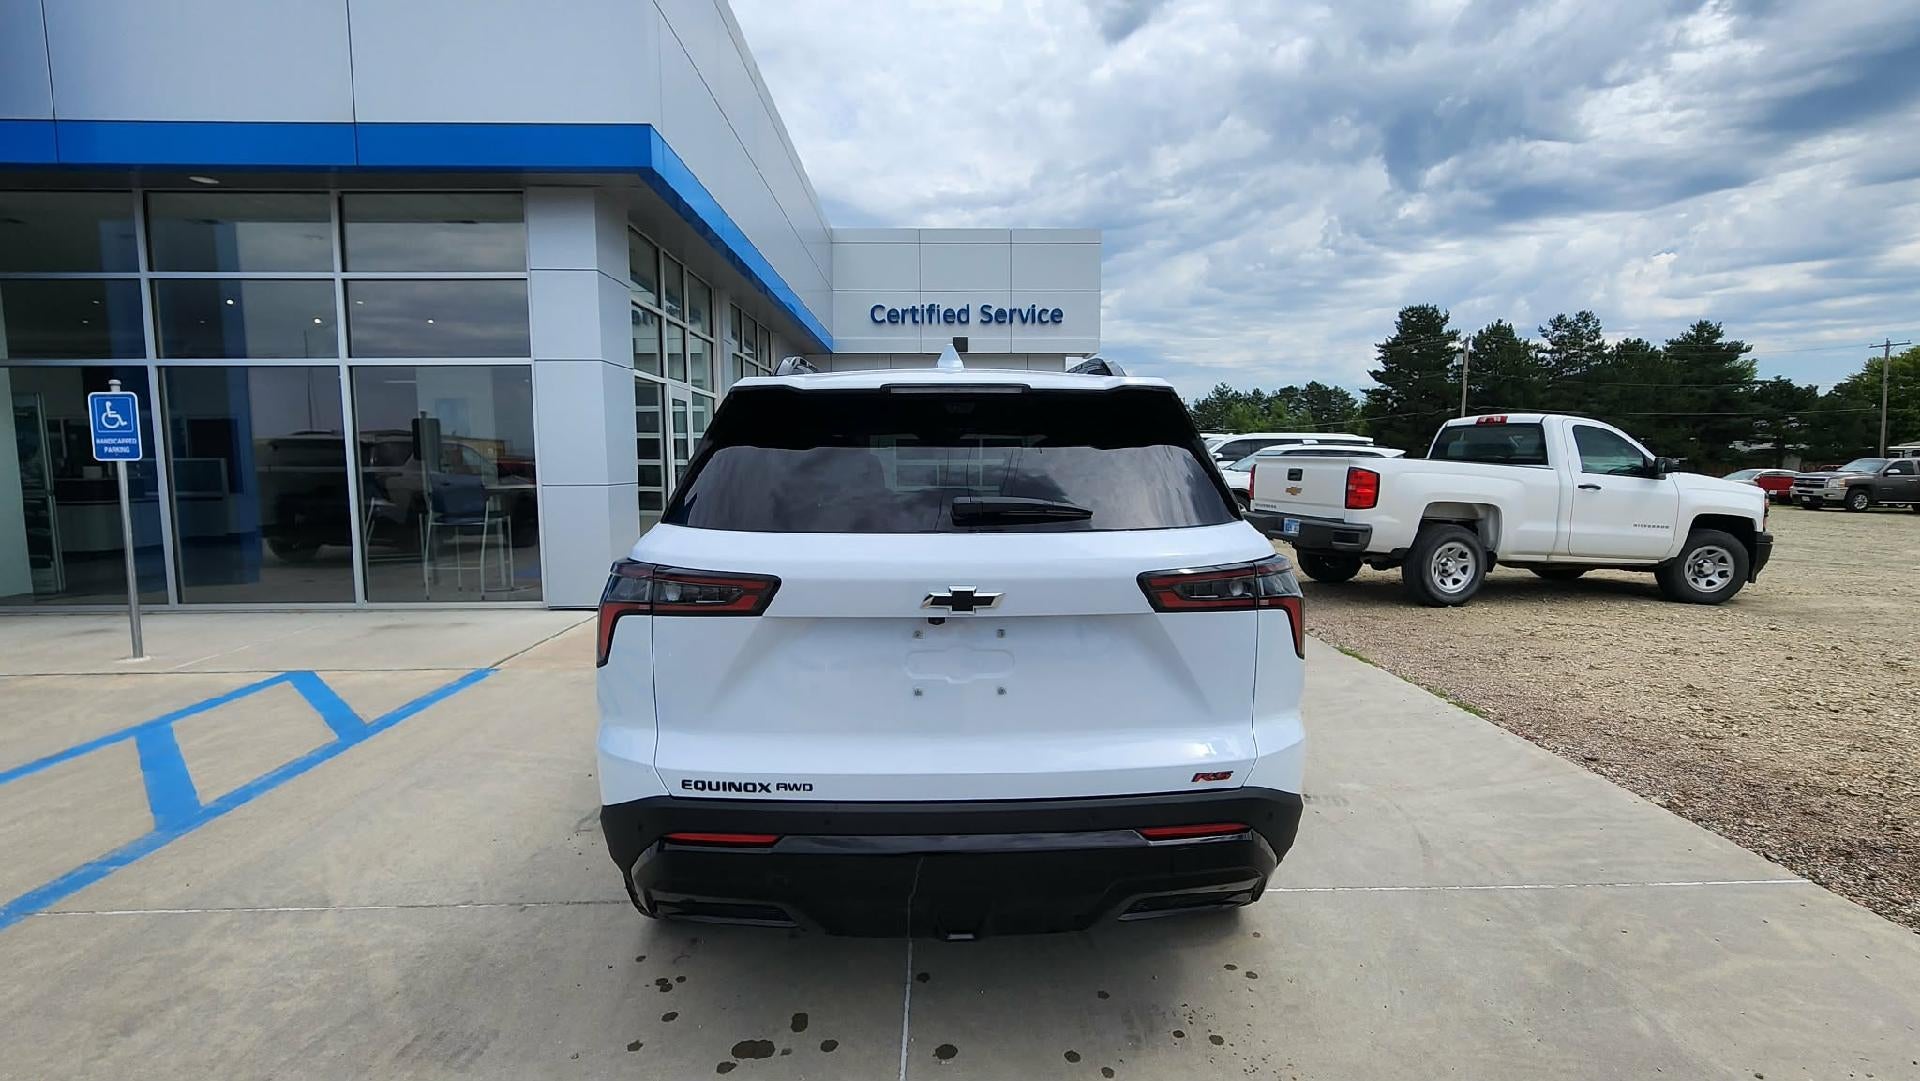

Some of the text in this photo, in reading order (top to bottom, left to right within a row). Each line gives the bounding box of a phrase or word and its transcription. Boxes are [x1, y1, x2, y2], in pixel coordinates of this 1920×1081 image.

[870, 303, 1064, 325] Certified Service
[1191, 770, 1234, 782] RS
[681, 779, 814, 793] EQUINOX AWD
